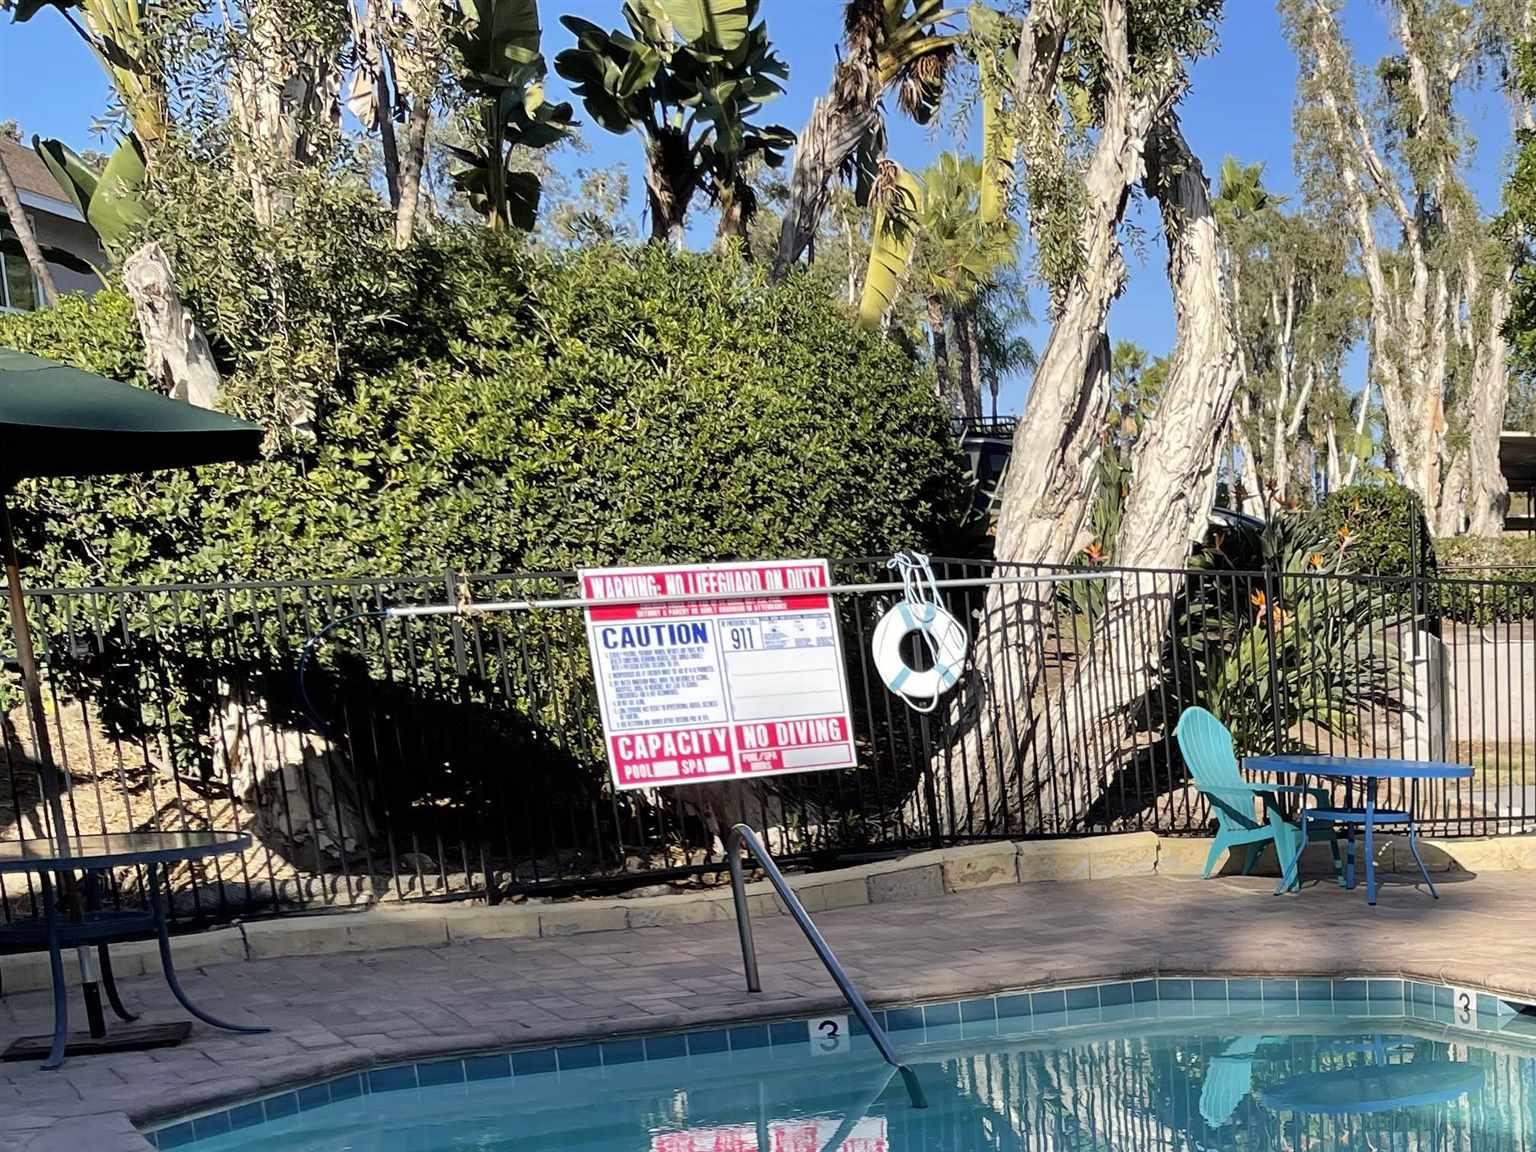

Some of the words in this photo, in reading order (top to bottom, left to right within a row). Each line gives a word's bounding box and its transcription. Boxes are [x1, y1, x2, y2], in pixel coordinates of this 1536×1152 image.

[591, 574, 661, 599] WARNING:
[664, 572, 685, 595] NO
[687, 570, 761, 594] LIFEGUARD
[764, 568, 784, 591] ON
[786, 566, 821, 590] DUTY
[602, 623, 709, 649] CAUTION
[730, 627, 754, 650] 911
[618, 728, 727, 760] CAPACITY
[741, 725, 770, 749] NO
[775, 718, 842, 746] DIVING
[623, 763, 655, 780] POOL
[680, 758, 706, 775] SPA
[1458, 992, 1471, 1024] 3
[818, 1020, 840, 1049] 3
